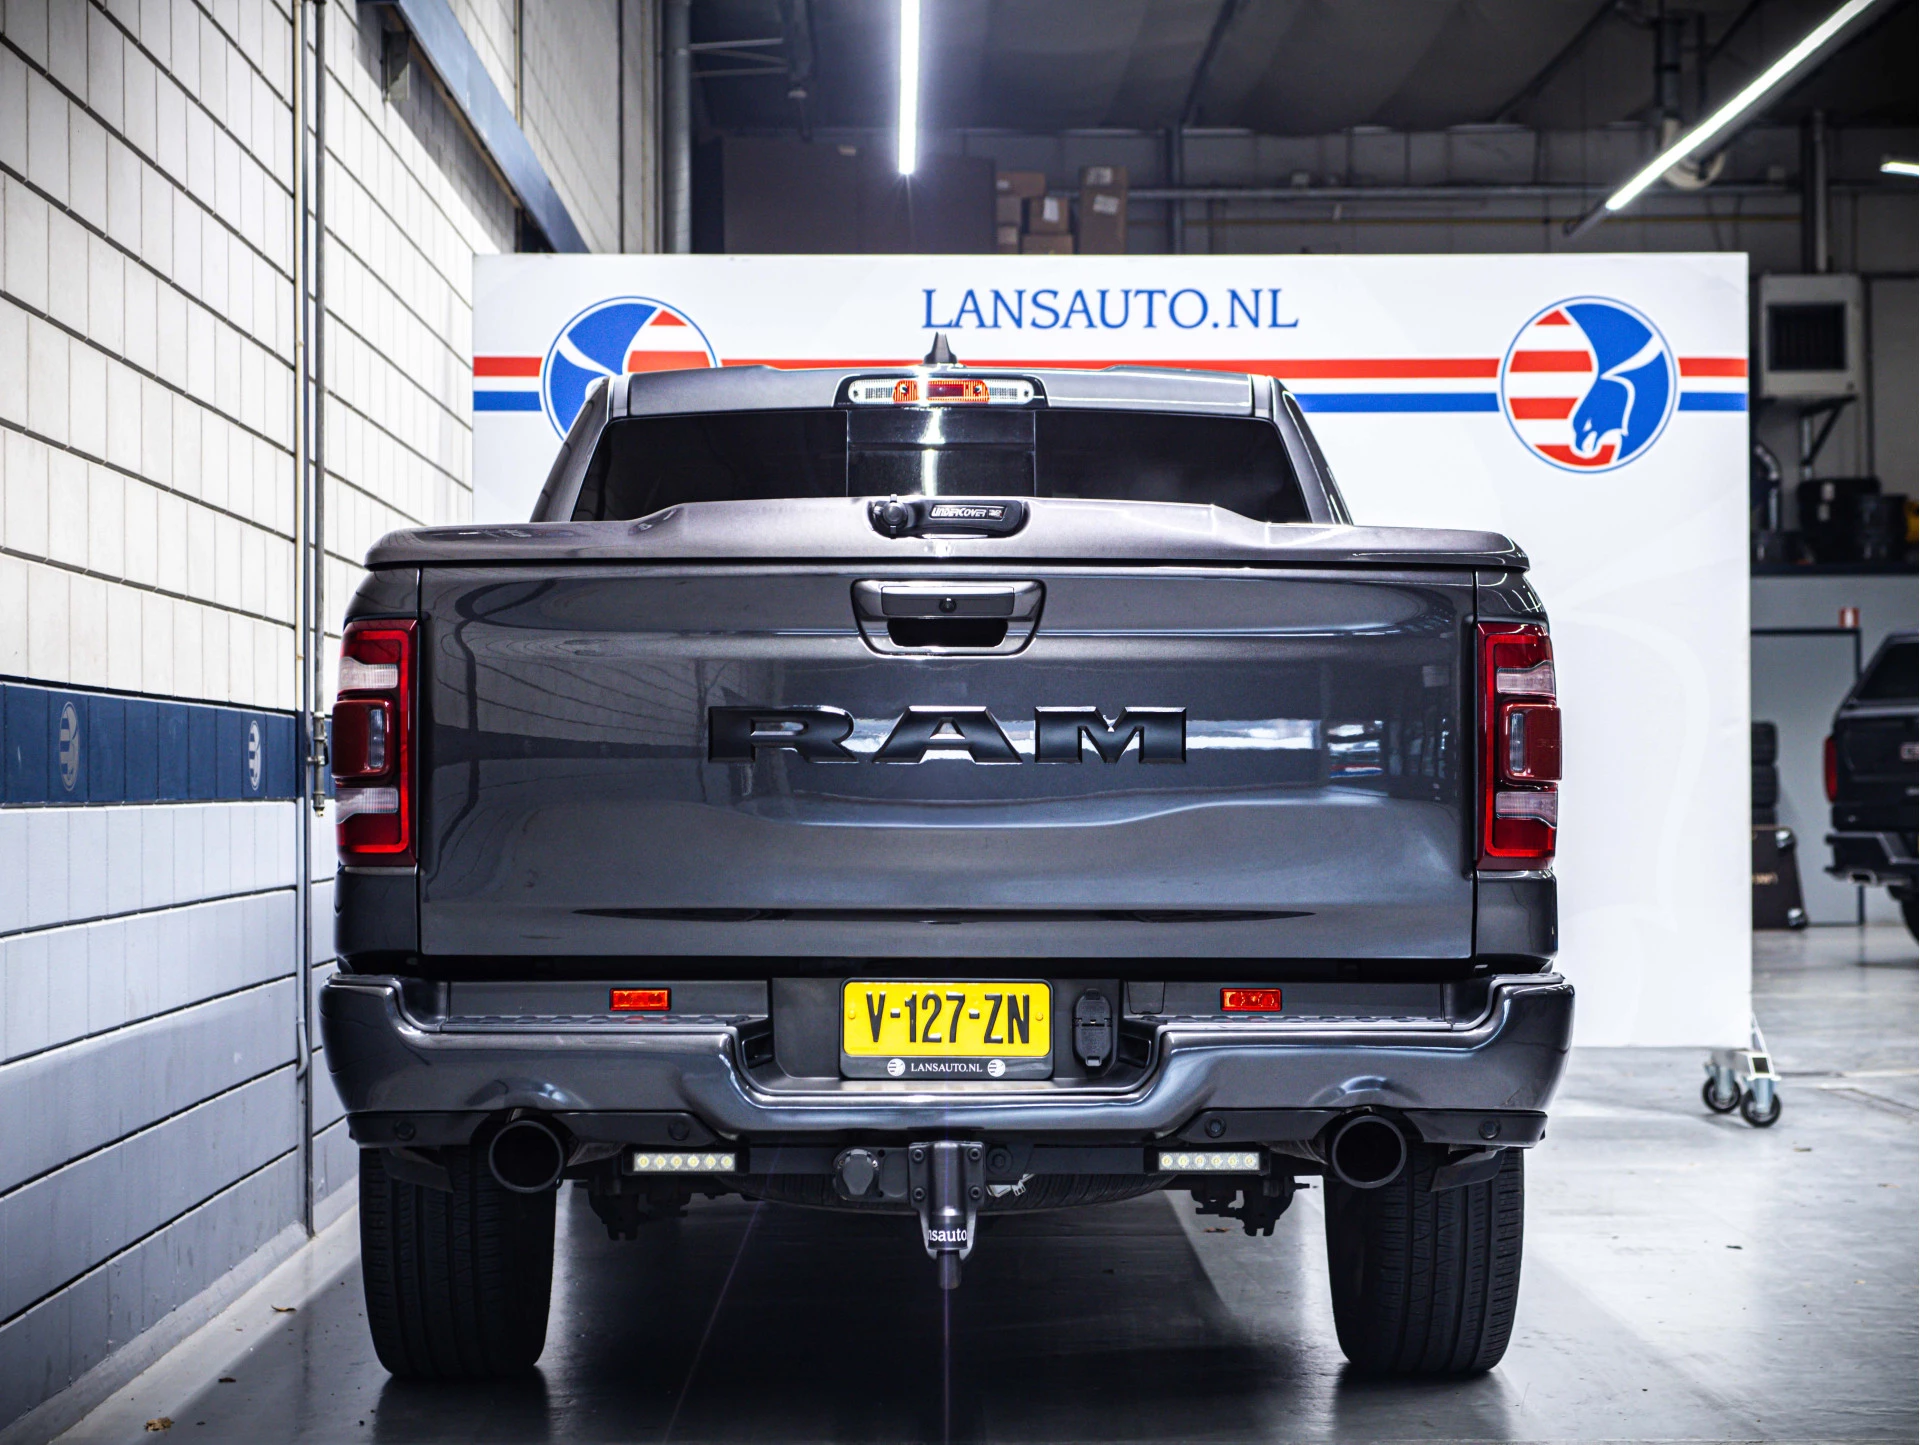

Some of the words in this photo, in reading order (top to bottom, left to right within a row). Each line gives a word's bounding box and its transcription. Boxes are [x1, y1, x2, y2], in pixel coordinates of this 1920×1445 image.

[922, 288, 1299, 330] LANSAUTO.NL
[708, 705, 1187, 765] RAM
[866, 991, 1030, 1044] V-127-ZN
[910, 1063, 983, 1073] LANSAUTO.NL
